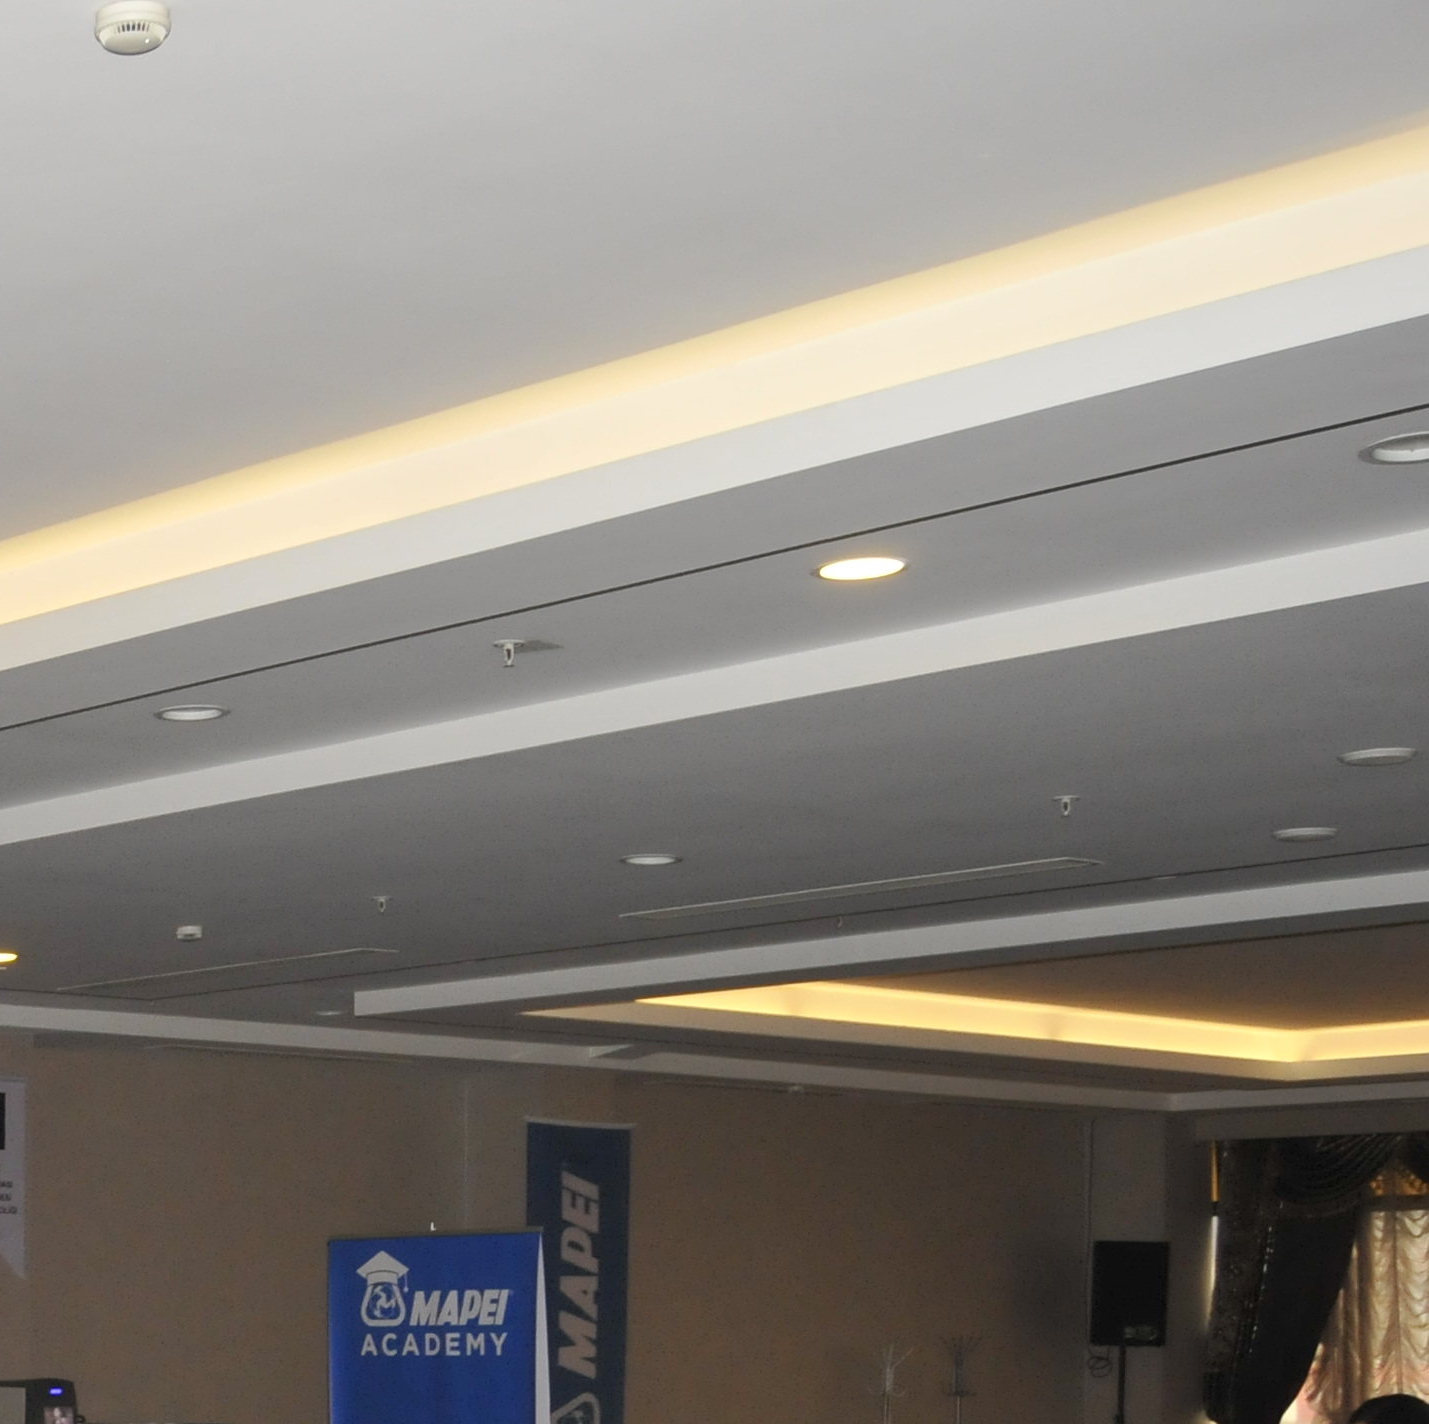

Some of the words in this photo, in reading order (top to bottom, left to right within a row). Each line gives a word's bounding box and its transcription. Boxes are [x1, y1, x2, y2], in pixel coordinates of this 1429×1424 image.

[557, 1171, 600, 1379] MAPEI
[409, 1288, 510, 1326] MAPEI
[361, 1332, 508, 1357] ACADEMY
